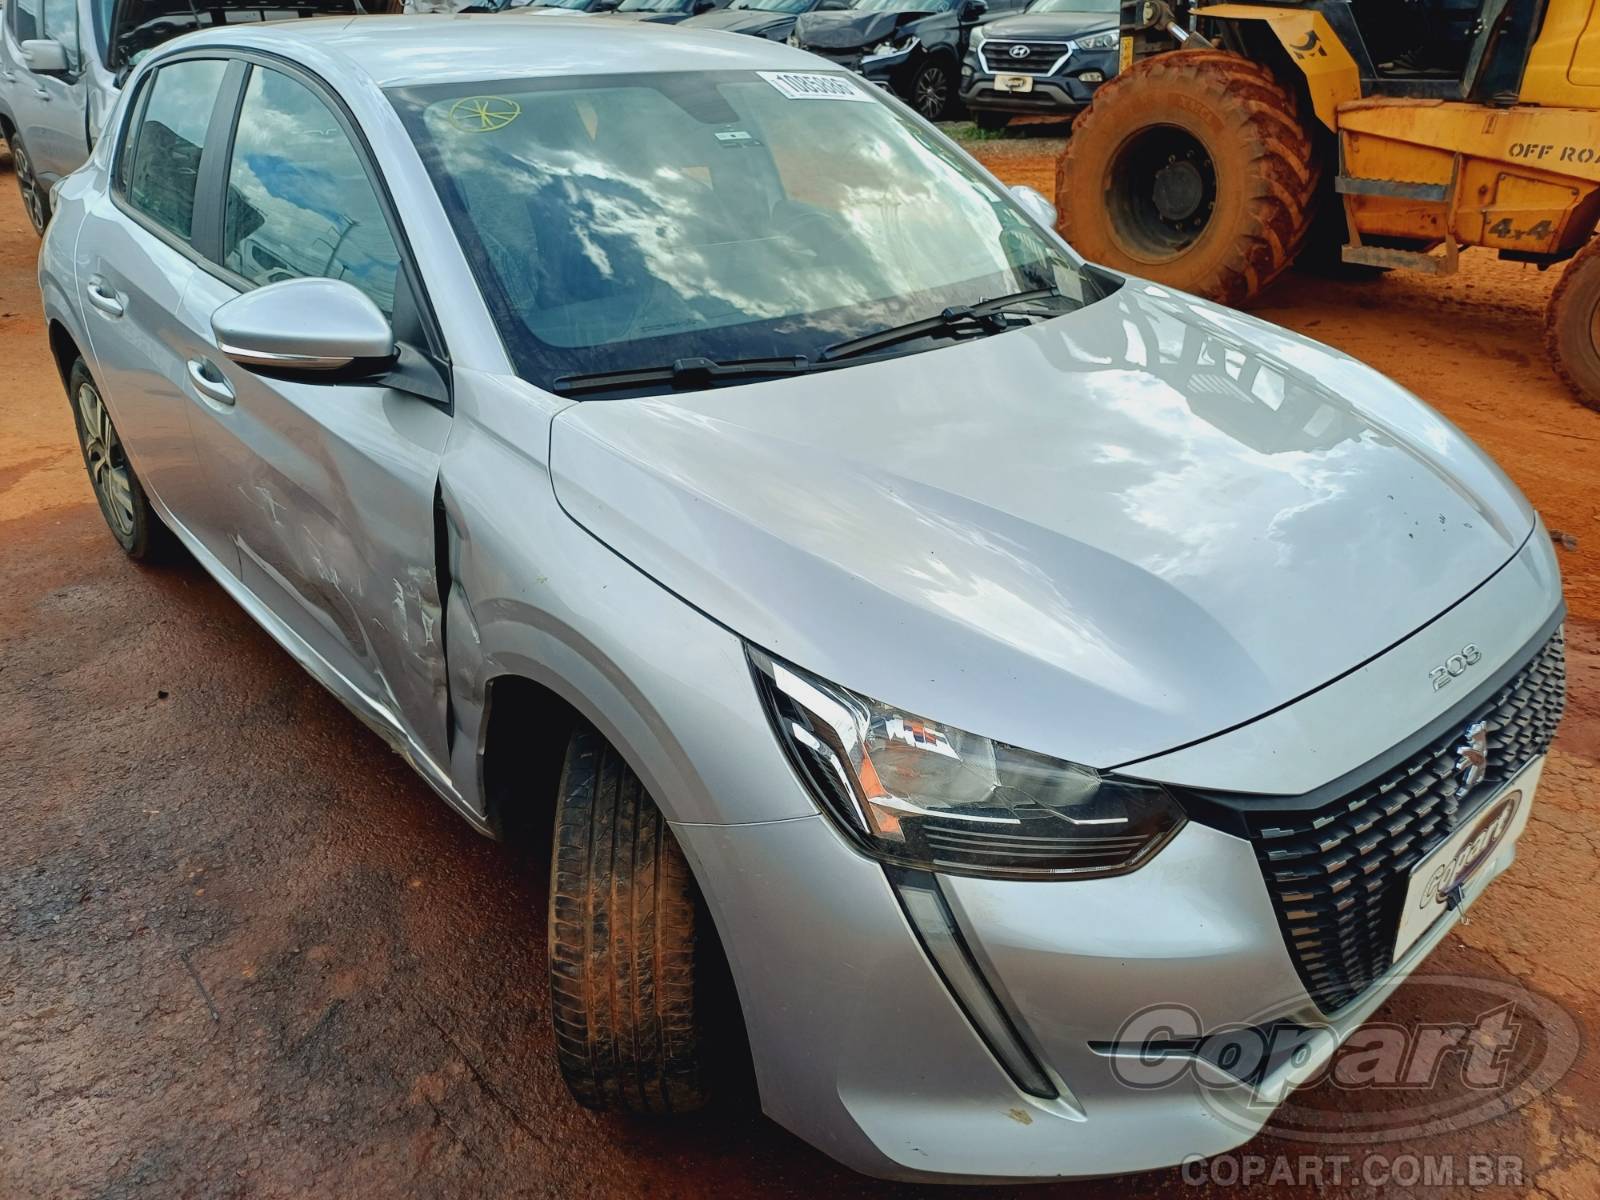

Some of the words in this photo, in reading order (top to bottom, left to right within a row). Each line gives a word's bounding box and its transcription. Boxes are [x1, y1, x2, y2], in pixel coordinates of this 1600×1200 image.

[1508, 142, 1554, 159] OFF
[1487, 217, 1553, 240] 4x4
[1428, 643, 1482, 692] 208
